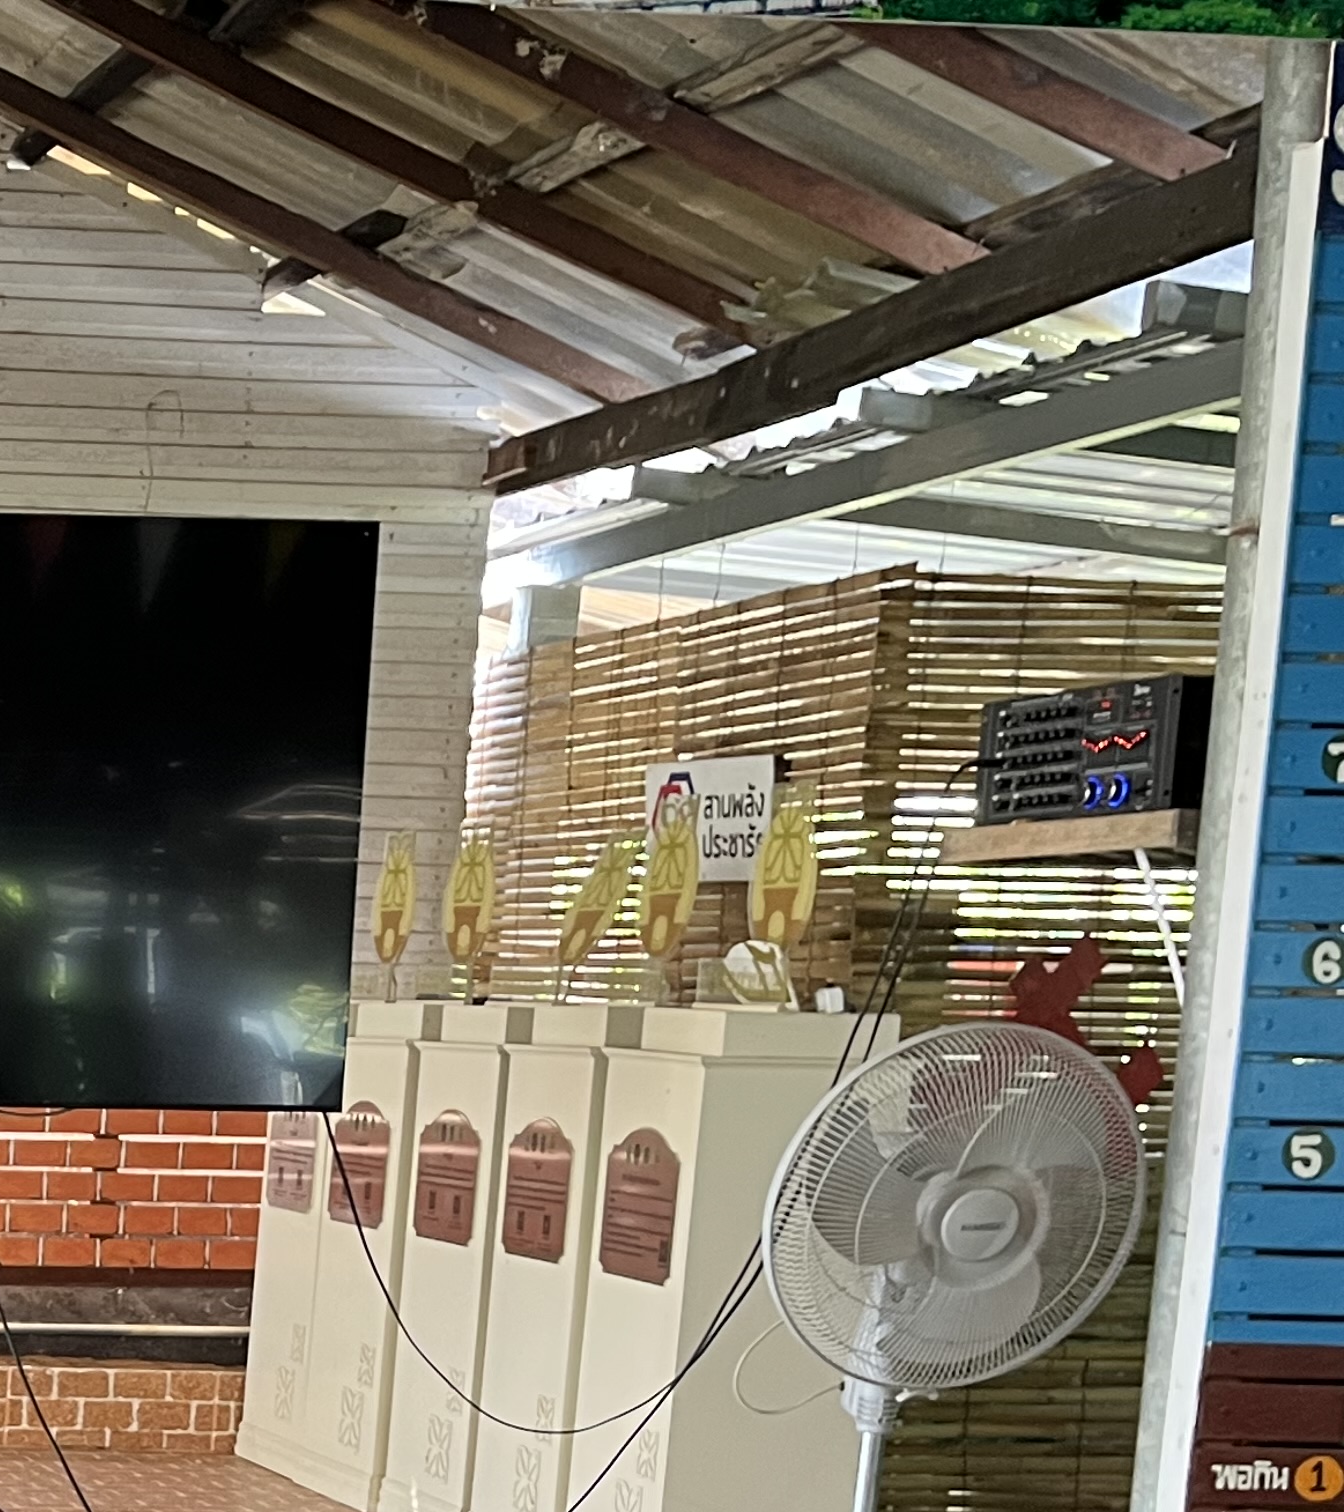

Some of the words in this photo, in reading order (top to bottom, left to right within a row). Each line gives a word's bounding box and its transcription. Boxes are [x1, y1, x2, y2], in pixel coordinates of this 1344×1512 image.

[703, 782, 765, 820] สานพลัง
[1312, 940, 1342, 984] 6
[1290, 1134, 1323, 1180] 5
[1211, 1459, 1289, 1491] พอกิน
[1309, 1460, 1327, 1492] 1
